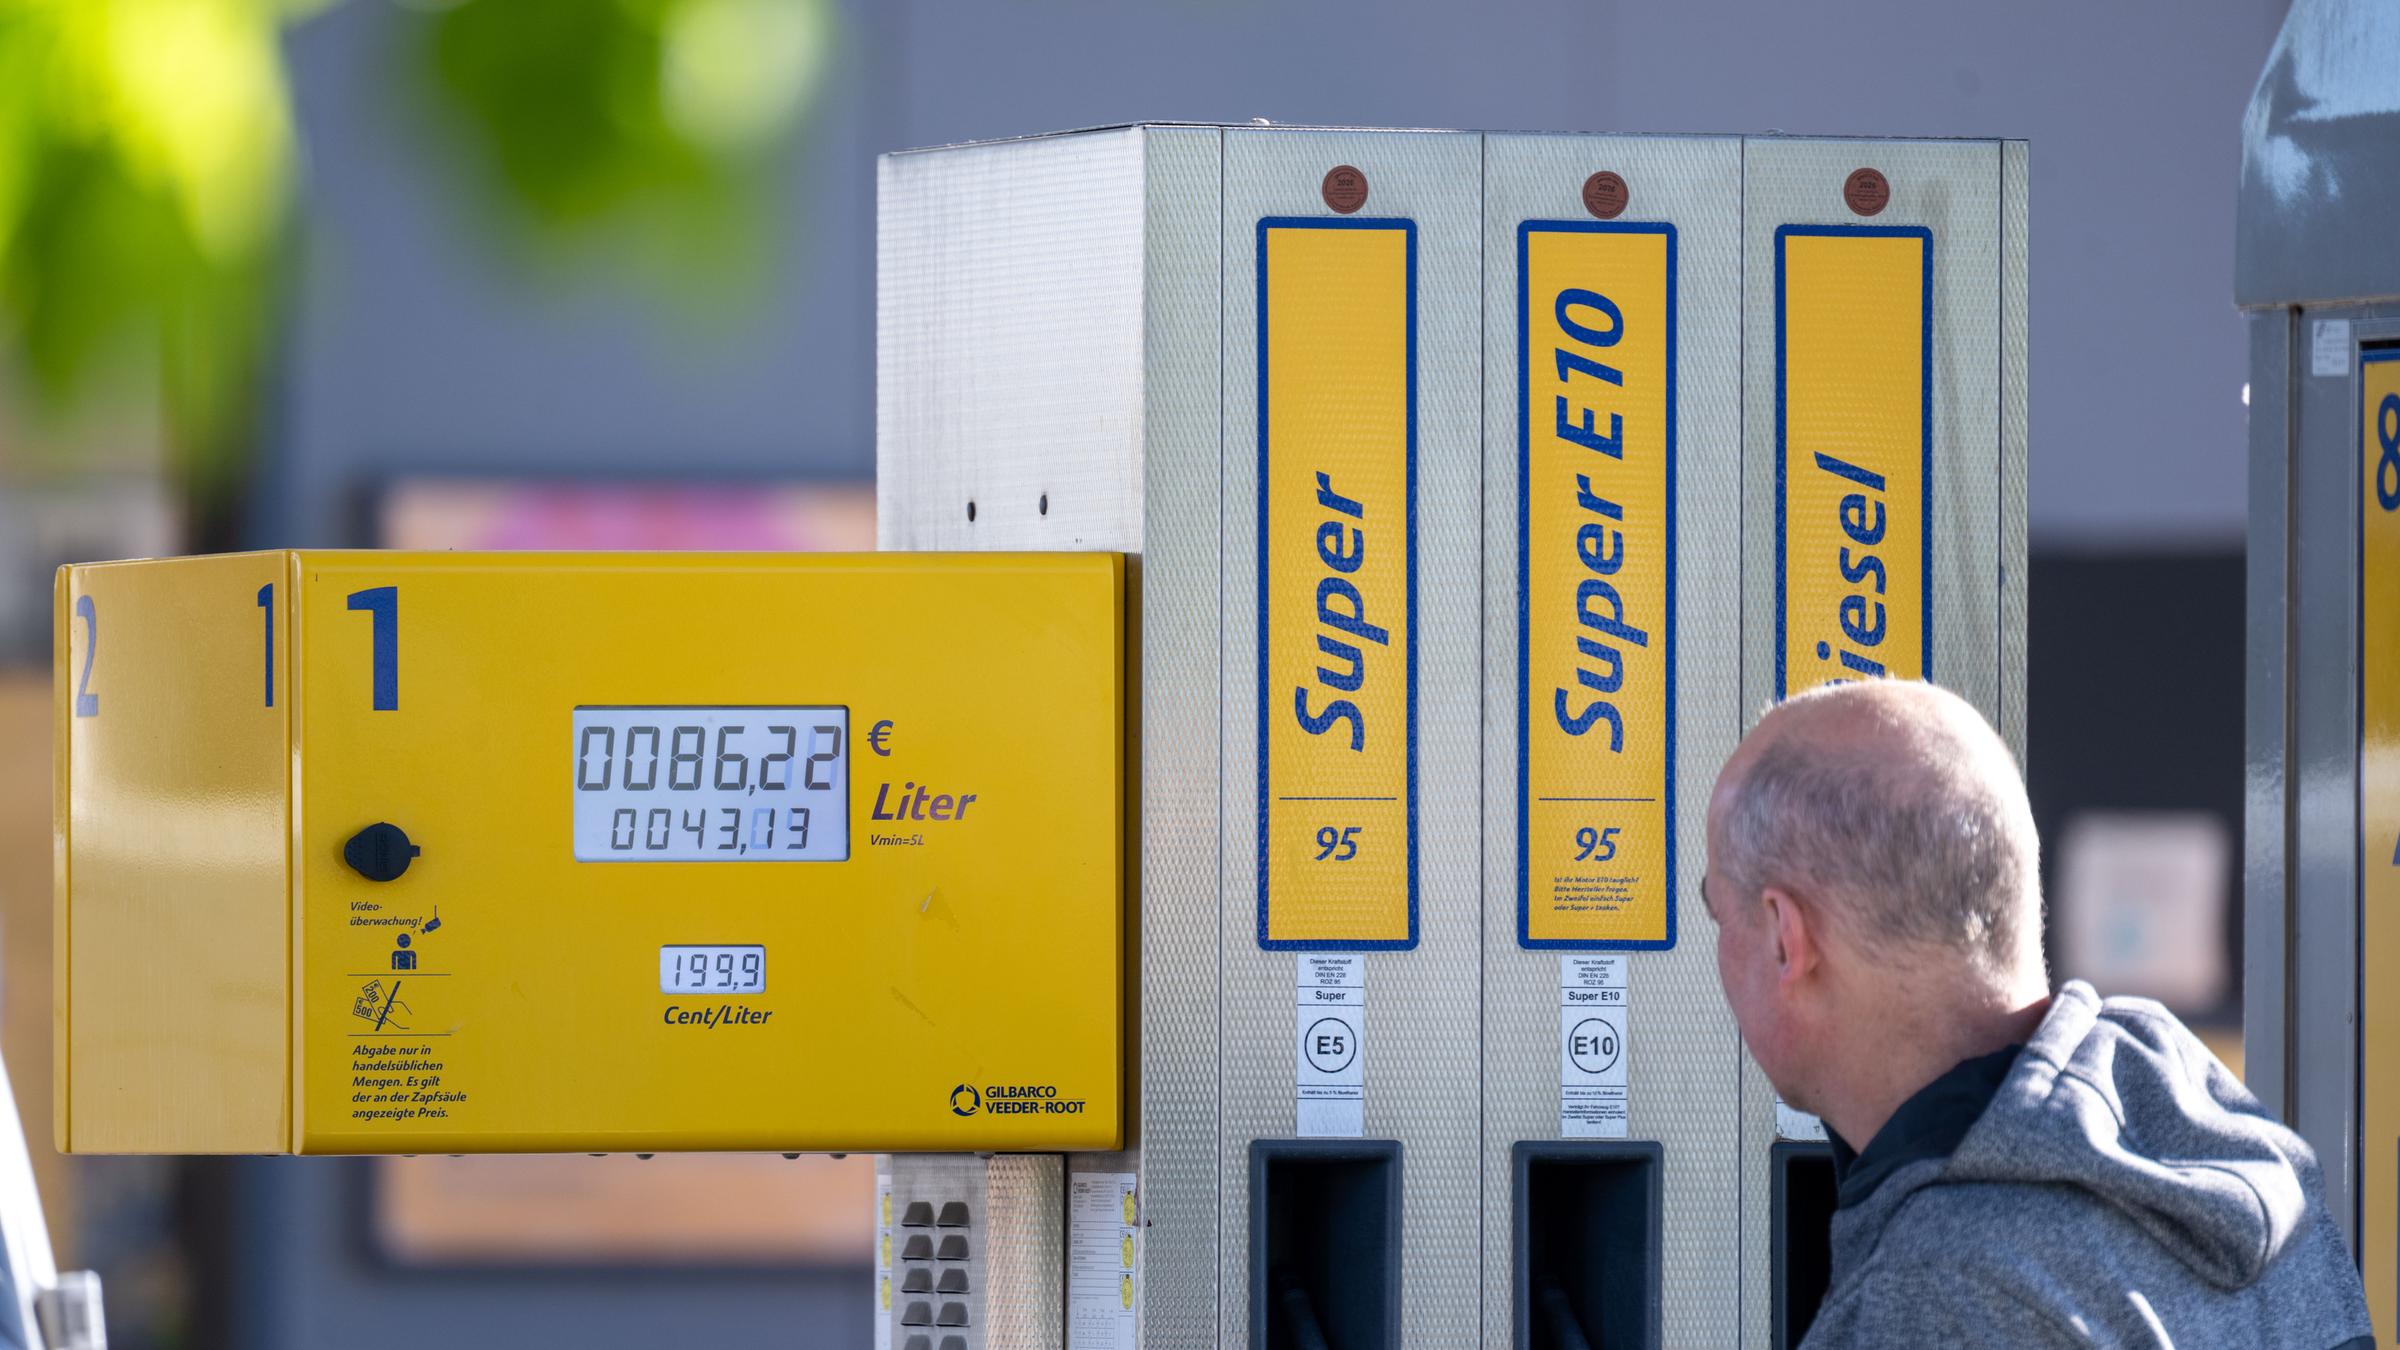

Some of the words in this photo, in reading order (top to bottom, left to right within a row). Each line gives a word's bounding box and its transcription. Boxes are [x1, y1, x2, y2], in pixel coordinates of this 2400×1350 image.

[1554, 288, 1624, 461] E10
[1815, 451, 1887, 686] iesel
[1295, 470, 1389, 753] Super
[1555, 473, 1648, 754] Super
[76, 594, 99, 717] 2
[258, 583, 274, 708] 1
[347, 586, 399, 712] 1
[577, 725, 842, 796] 0086,22
[871, 781, 977, 821] Liter
[610, 807, 811, 855] 0043,13
[1315, 826, 1362, 862] 95
[1574, 827, 1621, 862] 95
[349, 901, 383, 912] Video-
[349, 916, 423, 929] überwachung!
[674, 953, 760, 991] 199,9
[1315, 990, 1346, 1002] Super
[1568, 991, 1599, 1002] Super
[1601, 991, 1620, 1001] E10
[355, 1003, 373, 1018] 500
[663, 1004, 773, 1030] Cent/Liter
[352, 1045, 397, 1058] Abgabe
[399, 1047, 419, 1055] nur
[420, 1044, 432, 1055] in
[1317, 1035, 1345, 1055] E5
[1574, 1036, 1614, 1056] E10
[352, 1060, 443, 1071] handelsüblichen
[352, 1076, 403, 1089] Mengen.
[406, 1076, 418, 1086] Es
[421, 1075, 440, 1089] gilt
[985, 1085, 1057, 1099] GILBARCO
[352, 1092, 372, 1102] der
[373, 1094, 388, 1102] an
[389, 1091, 410, 1102] der
[411, 1091, 467, 1105] Zapfsäule
[985, 1101, 1086, 1114] VEEDER-ROOT
[352, 1107, 415, 1121] angezeigte
[417, 1107, 449, 1118] Preis.
